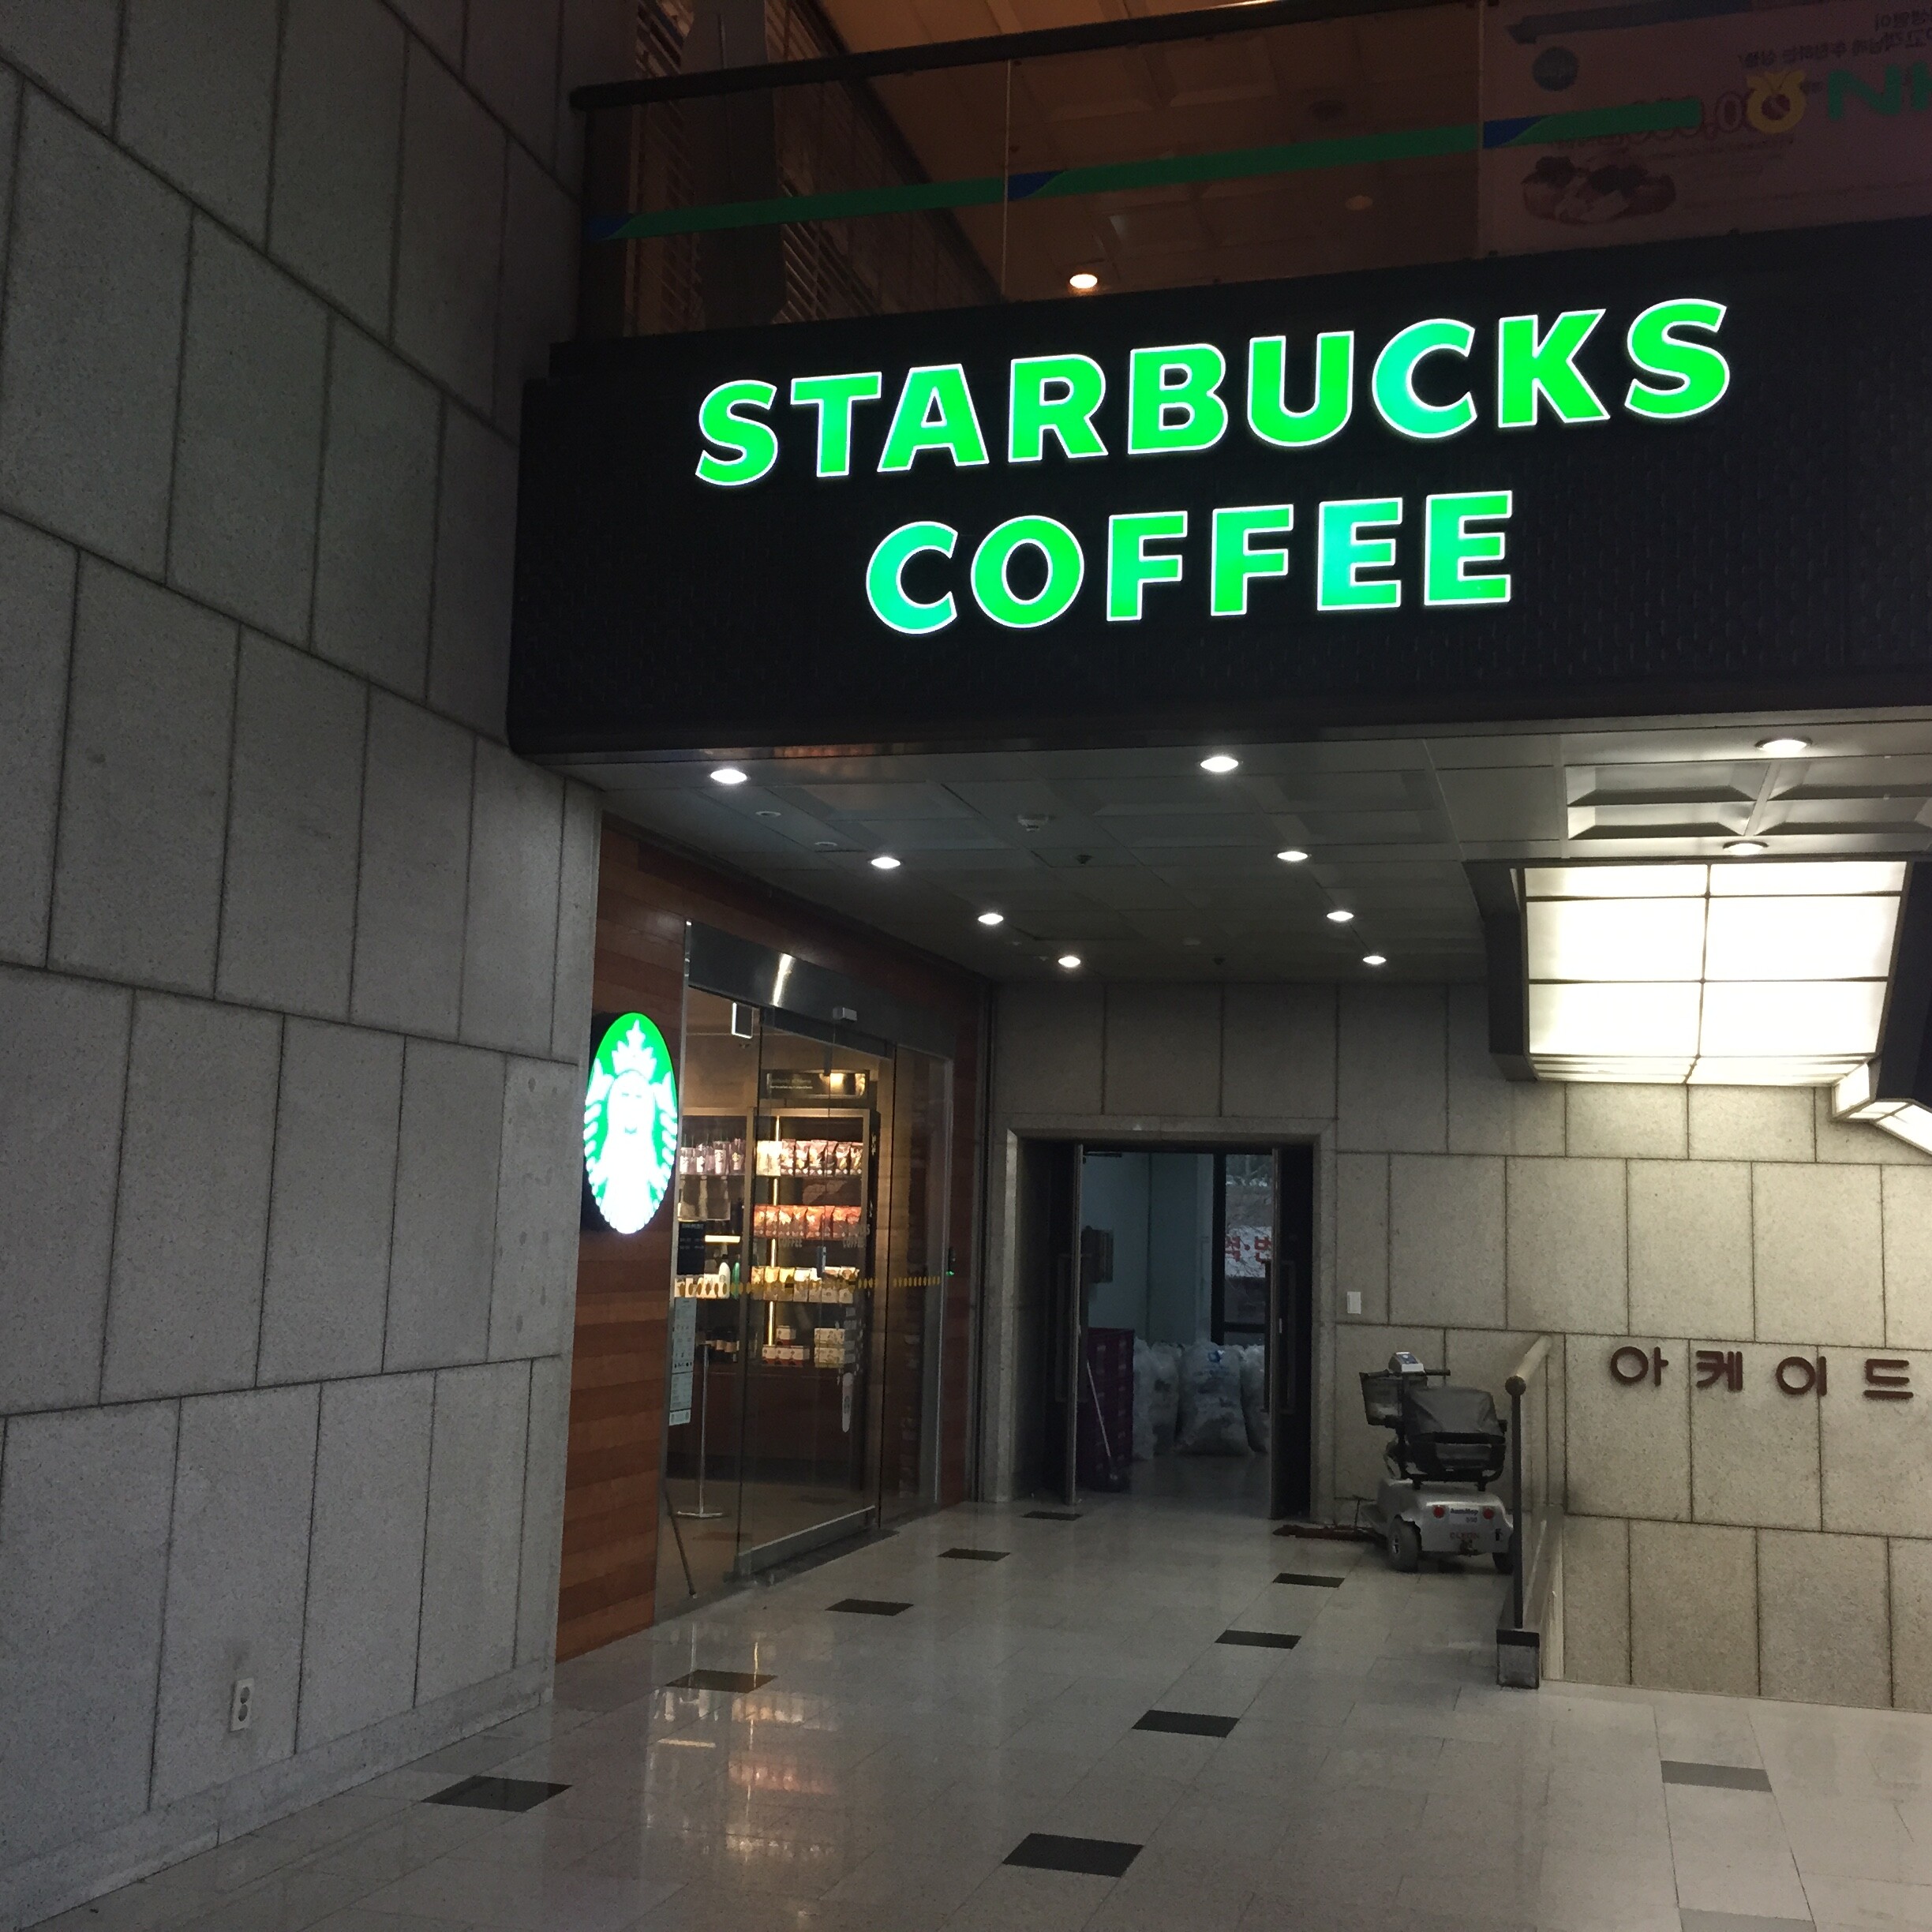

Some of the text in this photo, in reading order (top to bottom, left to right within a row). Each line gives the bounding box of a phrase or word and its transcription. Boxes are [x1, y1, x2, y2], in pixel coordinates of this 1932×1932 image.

[695, 298, 1731, 487] STARBUCKS
[865, 489, 1514, 635] COFFEE
[1610, 1345, 1914, 1400] 아케이드
